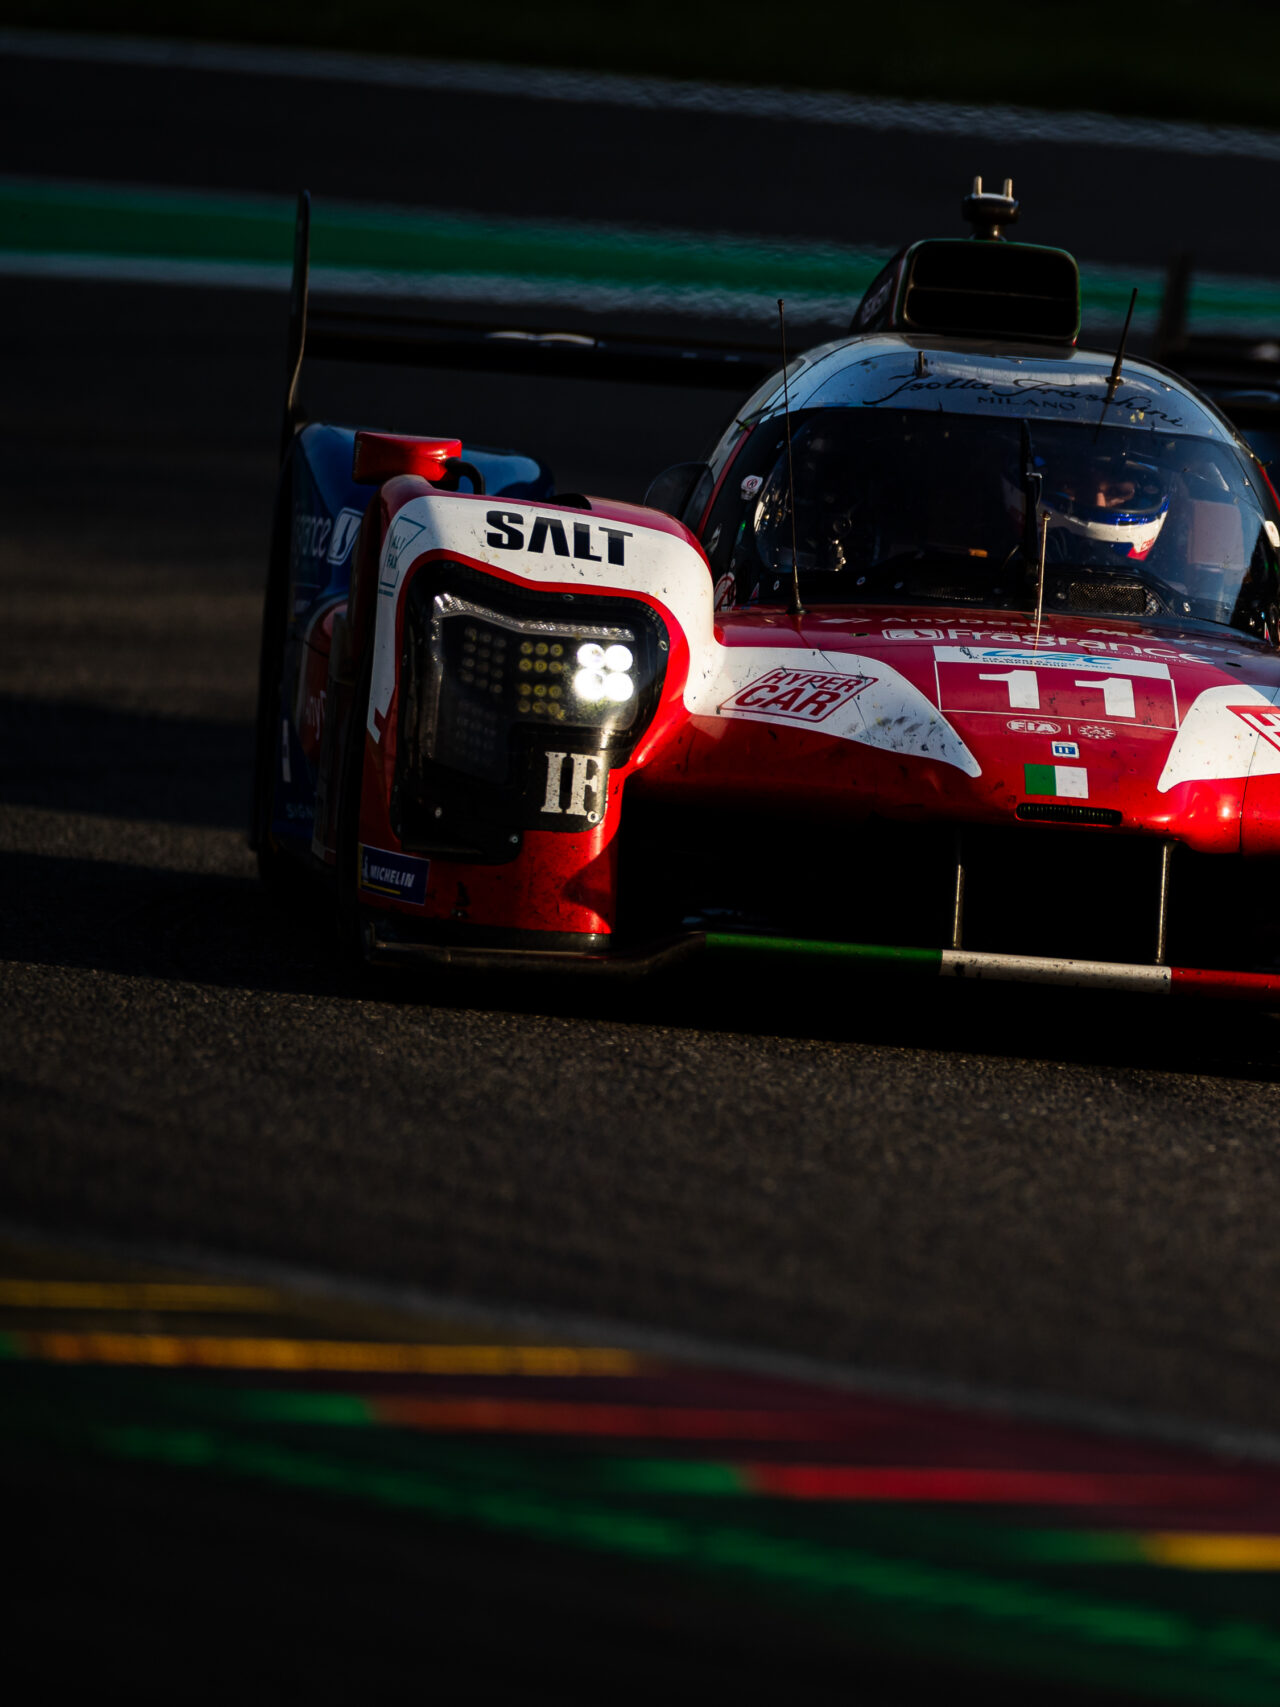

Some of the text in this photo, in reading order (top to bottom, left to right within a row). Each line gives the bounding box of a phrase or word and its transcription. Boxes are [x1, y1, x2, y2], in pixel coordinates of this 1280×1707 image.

[976, 396, 1077, 411] MILANO
[486, 509, 633, 566] SALT
[947, 628, 1217, 665] Fragrance
[982, 650, 1121, 665] WEC
[761, 671, 865, 692] HYPER
[978, 669, 1136, 718] 11
[735, 684, 841, 716] CAR
[1010, 721, 1056, 734] FIA
[540, 751, 604, 816] IF
[369, 864, 416, 888] MICHELIN
